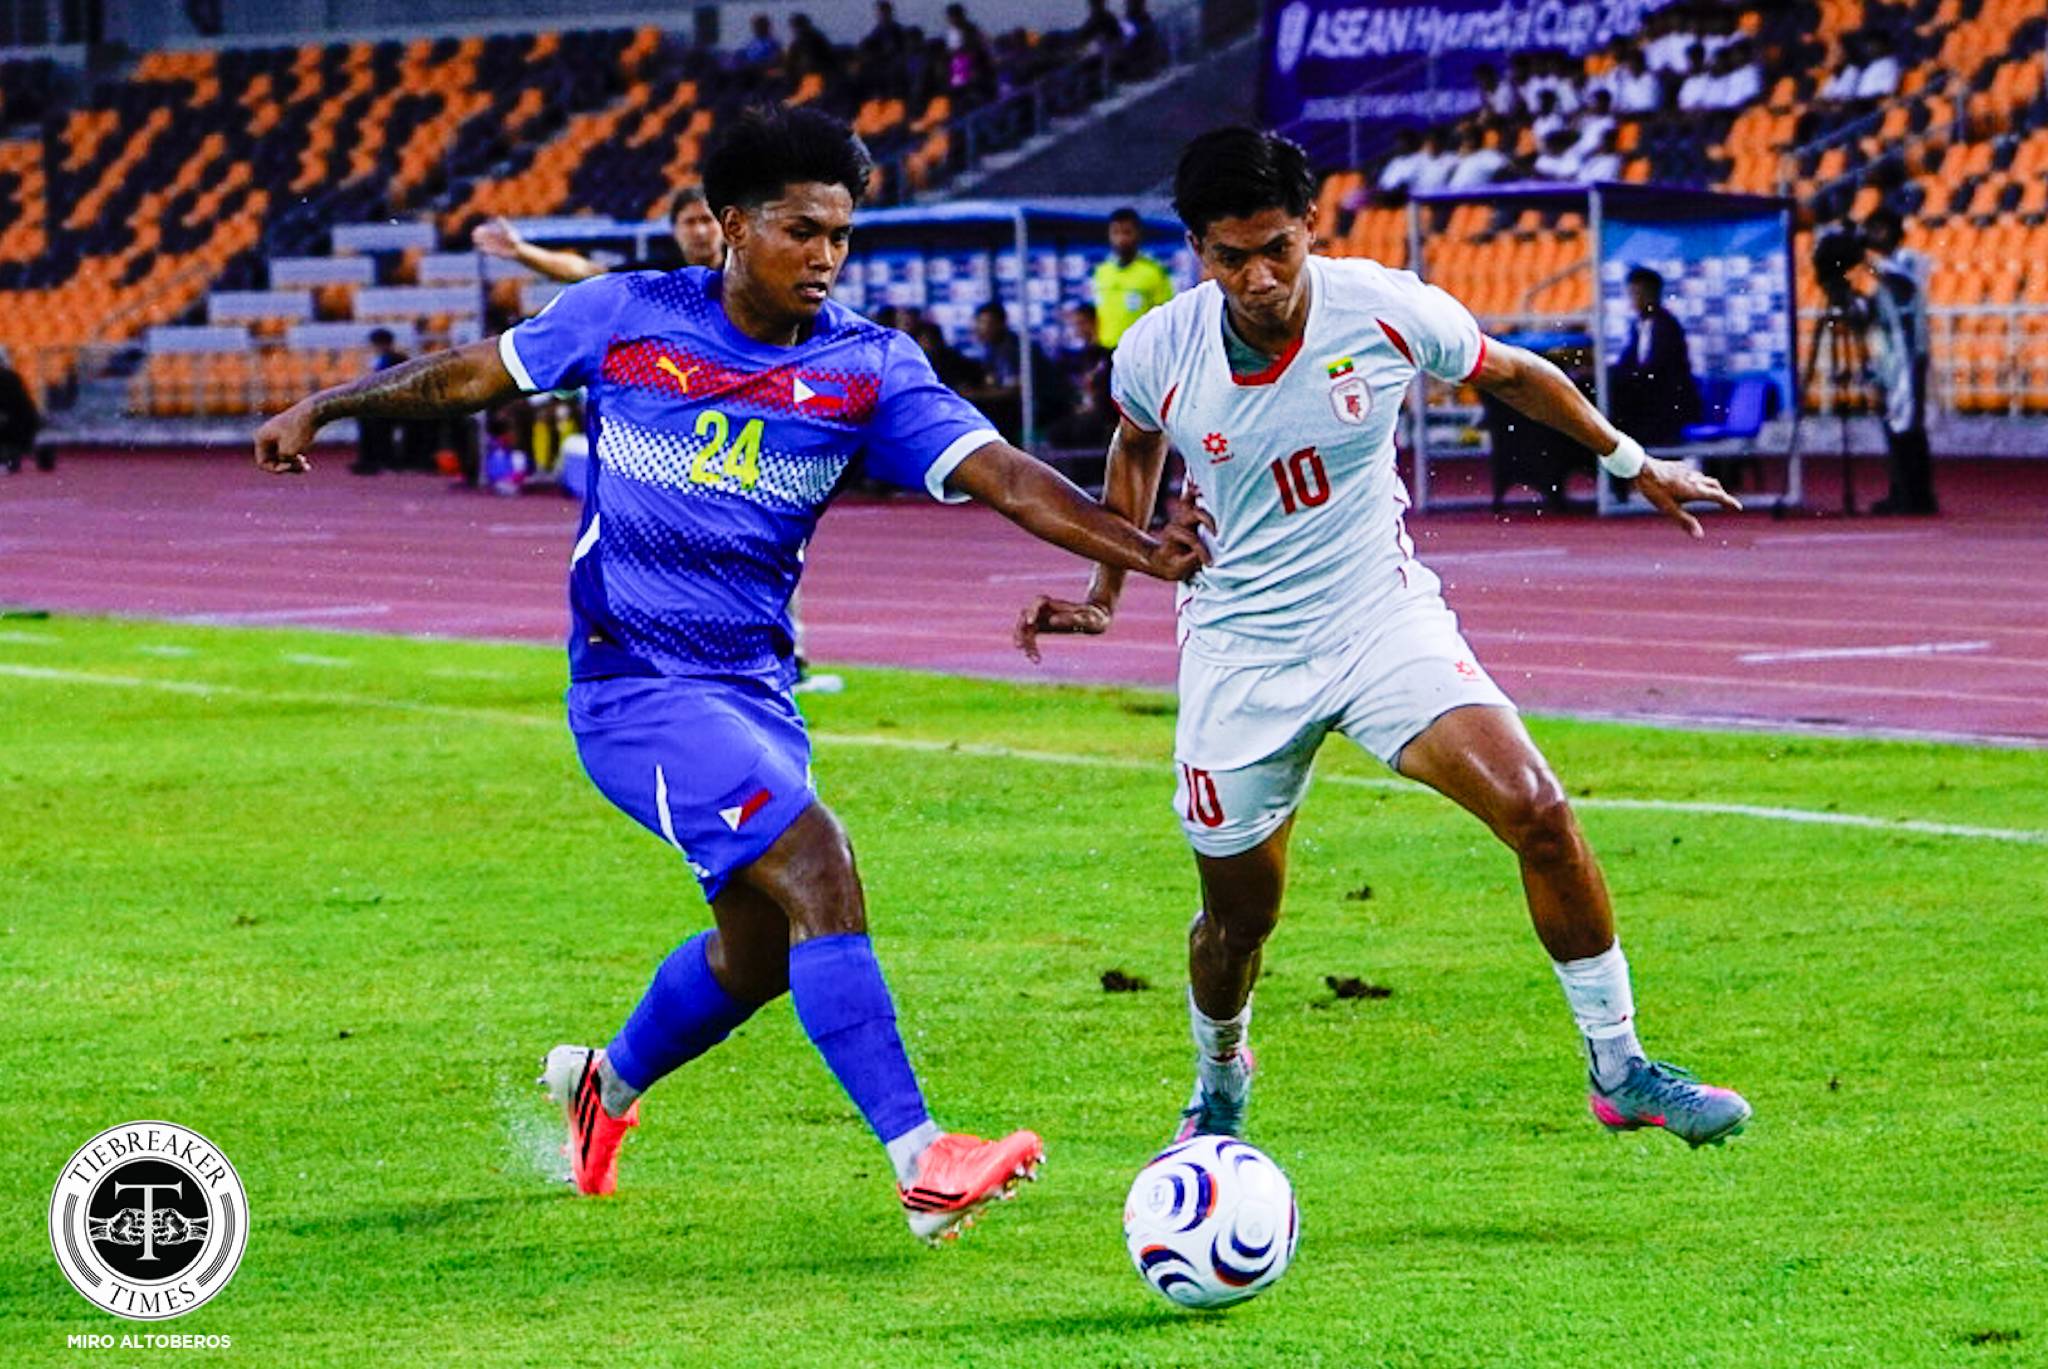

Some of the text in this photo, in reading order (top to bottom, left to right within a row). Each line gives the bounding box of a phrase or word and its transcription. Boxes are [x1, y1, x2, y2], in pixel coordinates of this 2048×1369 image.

[1306, 8, 1409, 57] ASEAN
[1536, 1, 1596, 55] Cup
[690, 409, 765, 490] 24
[1271, 446, 1331, 515] 10
[1182, 762, 1225, 828] 10
